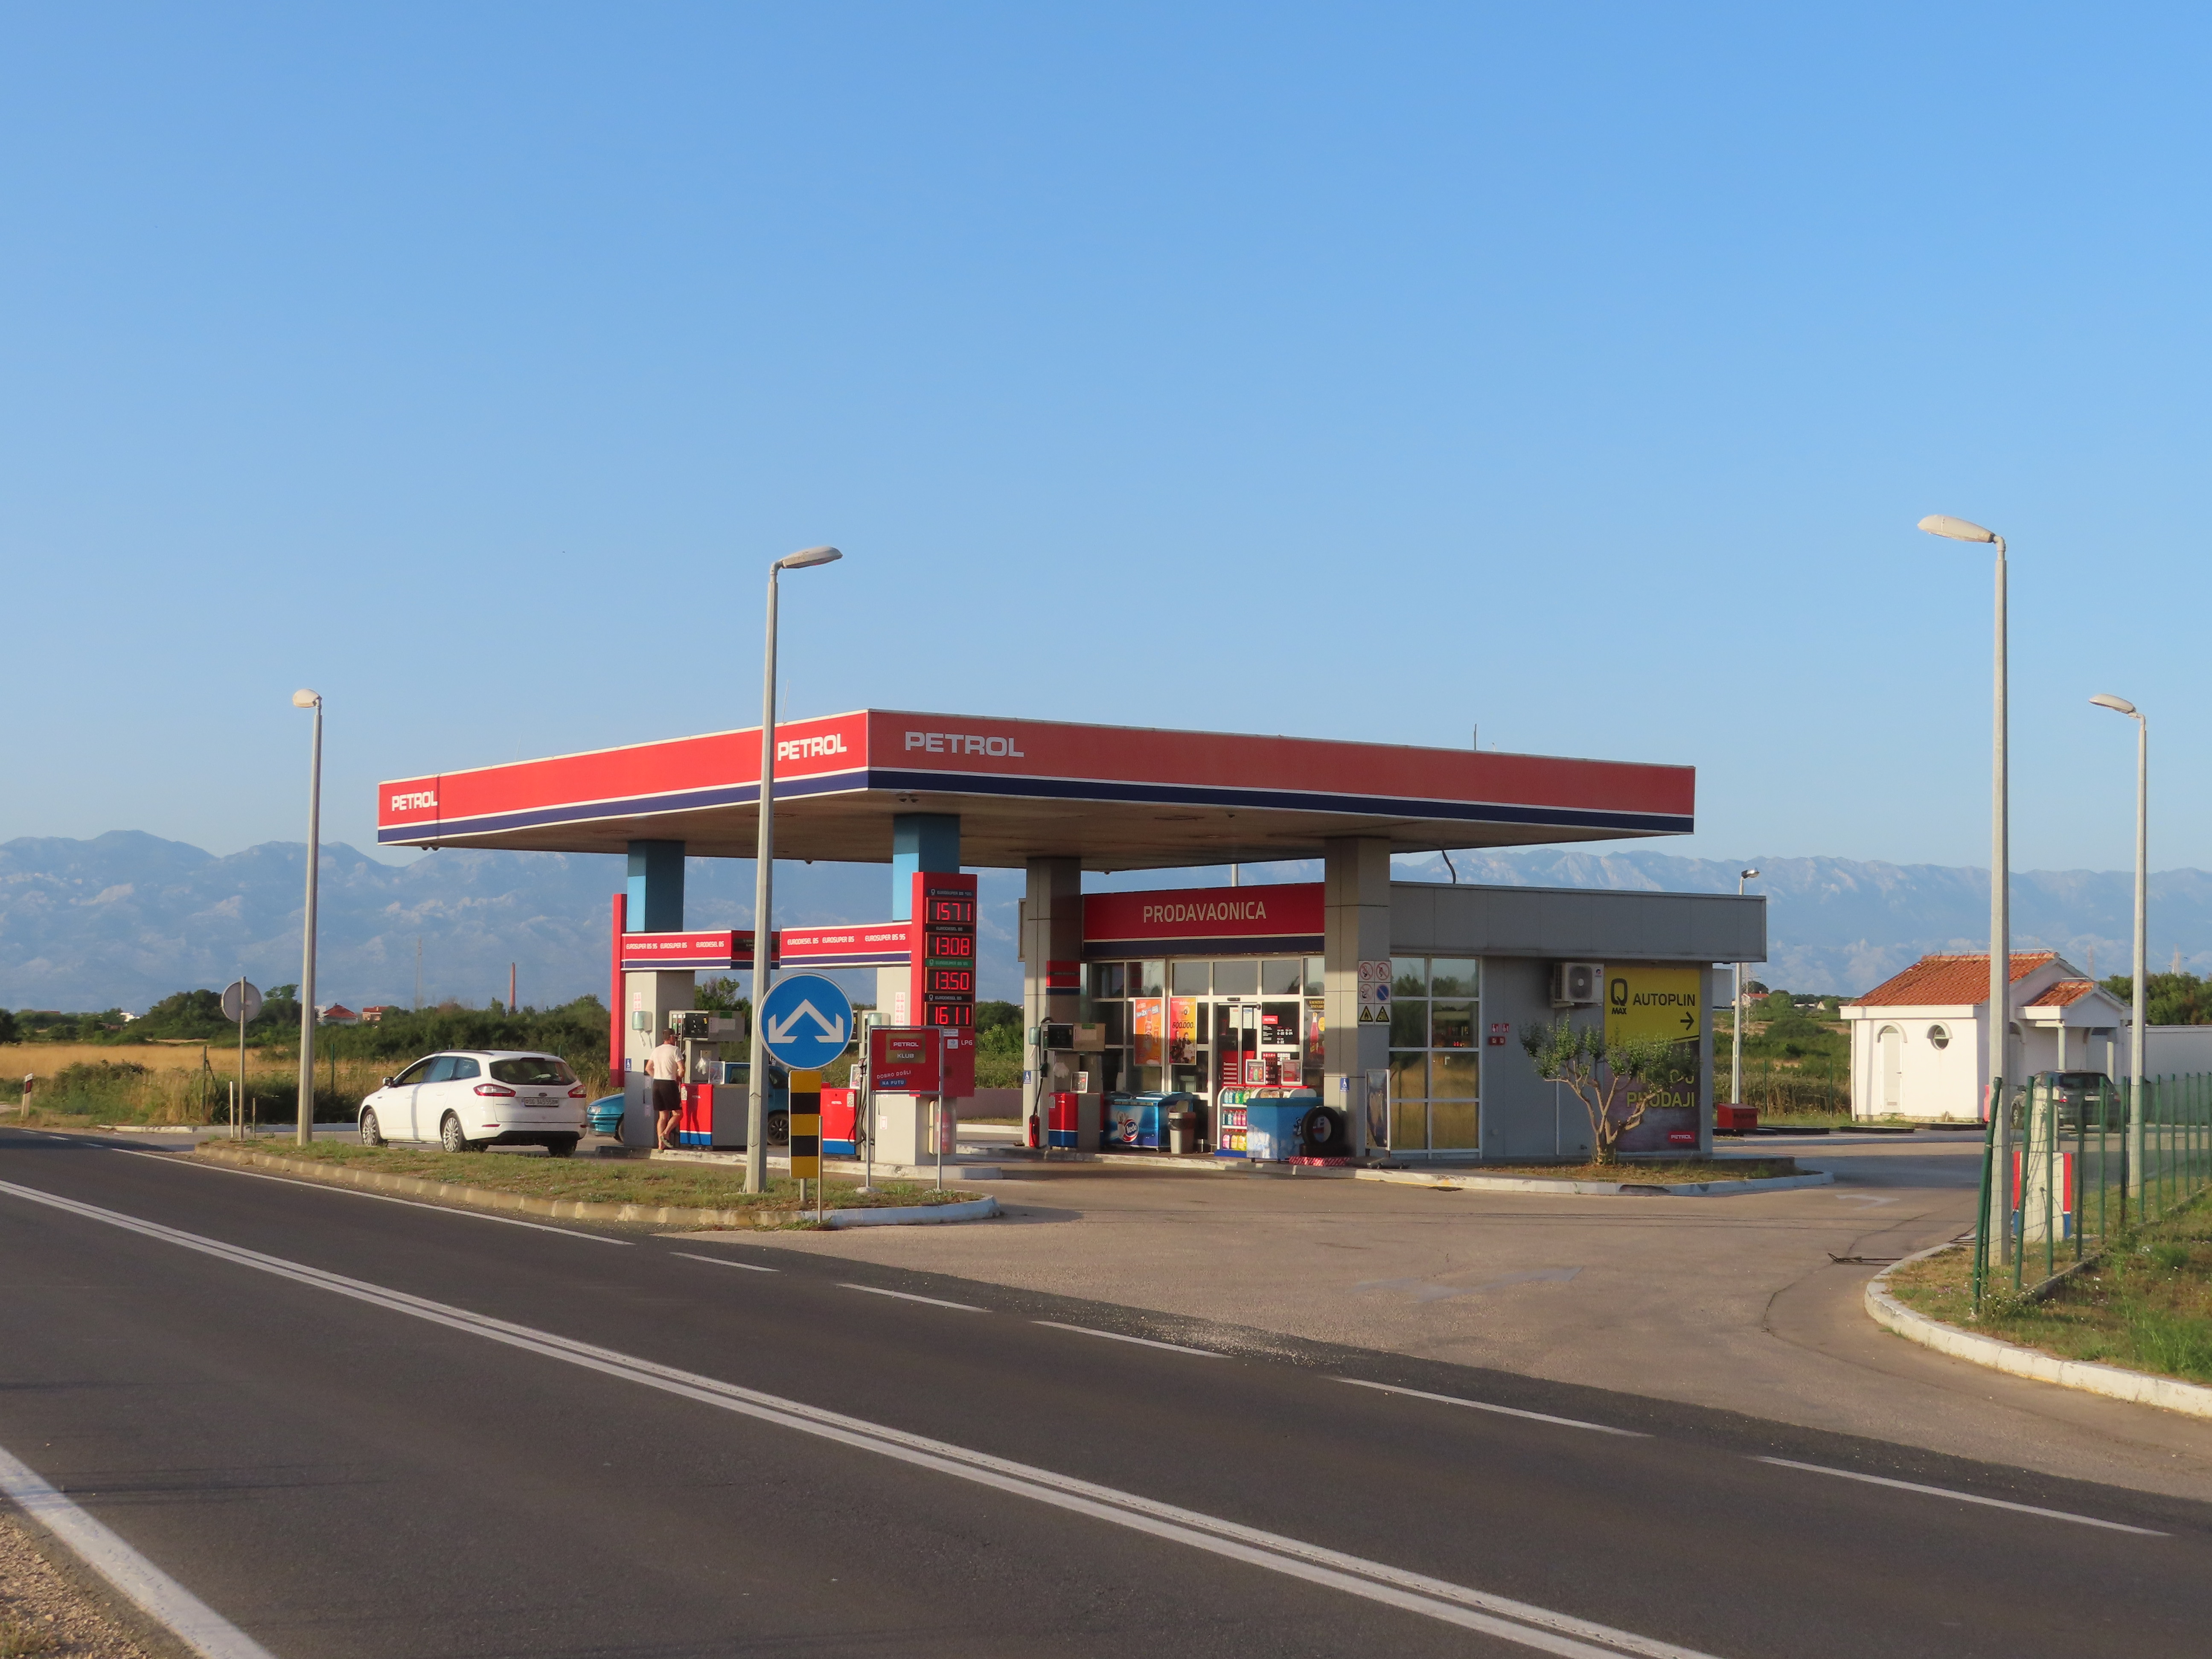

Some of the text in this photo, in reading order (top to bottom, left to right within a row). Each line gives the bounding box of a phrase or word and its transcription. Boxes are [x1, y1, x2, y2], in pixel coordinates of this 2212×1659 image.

[777, 733, 847, 761] PETROL
[905, 731, 1024, 757] PETROL
[392, 790, 438, 812] PETROL
[937, 902, 971, 921] 1571
[1143, 902, 1266, 923] PRODAVAONICA
[936, 937, 970, 955] 1308
[1611, 978, 1628, 1006] Q
[1633, 993, 1695, 1006] AUTOPLIN
